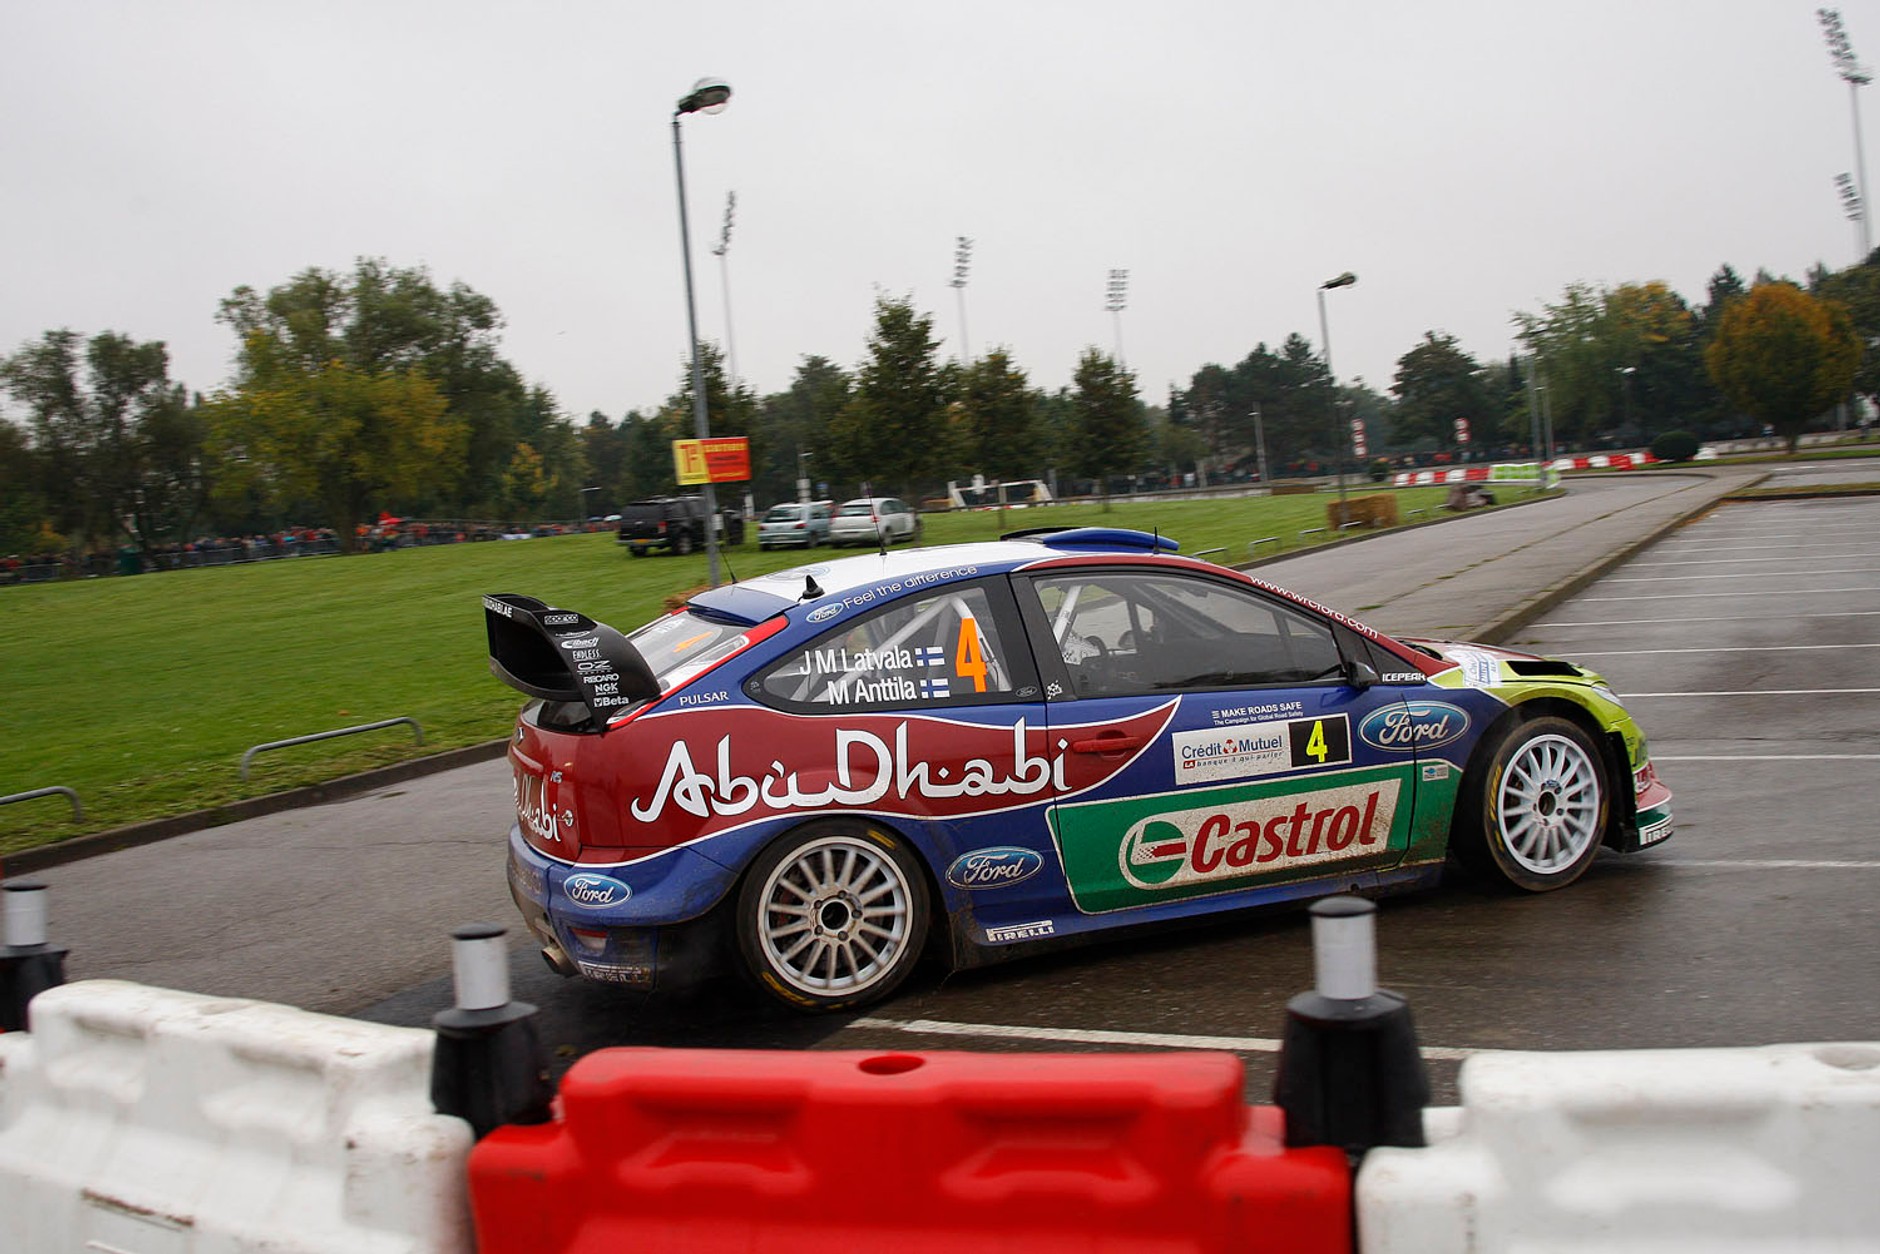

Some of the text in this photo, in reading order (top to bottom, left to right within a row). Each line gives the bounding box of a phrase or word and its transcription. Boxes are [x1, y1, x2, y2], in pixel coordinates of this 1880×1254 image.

[842, 589, 876, 609] Feel
[878, 583, 902, 598] the
[904, 566, 977, 589] difference
[799, 645, 914, 676] J M Latvala
[955, 617, 987, 692] 4
[584, 673, 620, 684] RECARO
[595, 682, 618, 692] NGK
[827, 676, 917, 706] M Anttila
[602, 696, 629, 706] Beta
[680, 691, 730, 706] PULSAR
[1221, 701, 1303, 718] MAKE ROADS SAFE
[1379, 708, 1450, 745] Ford
[1181, 735, 1283, 760] Crédit Mutuel
[1306, 720, 1328, 763] 4
[1197, 757, 1228, 768] banque
[1191, 790, 1381, 874] Castrol
[964, 854, 1025, 885] Ford
[571, 878, 615, 903] Ford
[985, 920, 1056, 944] PIRELLI
